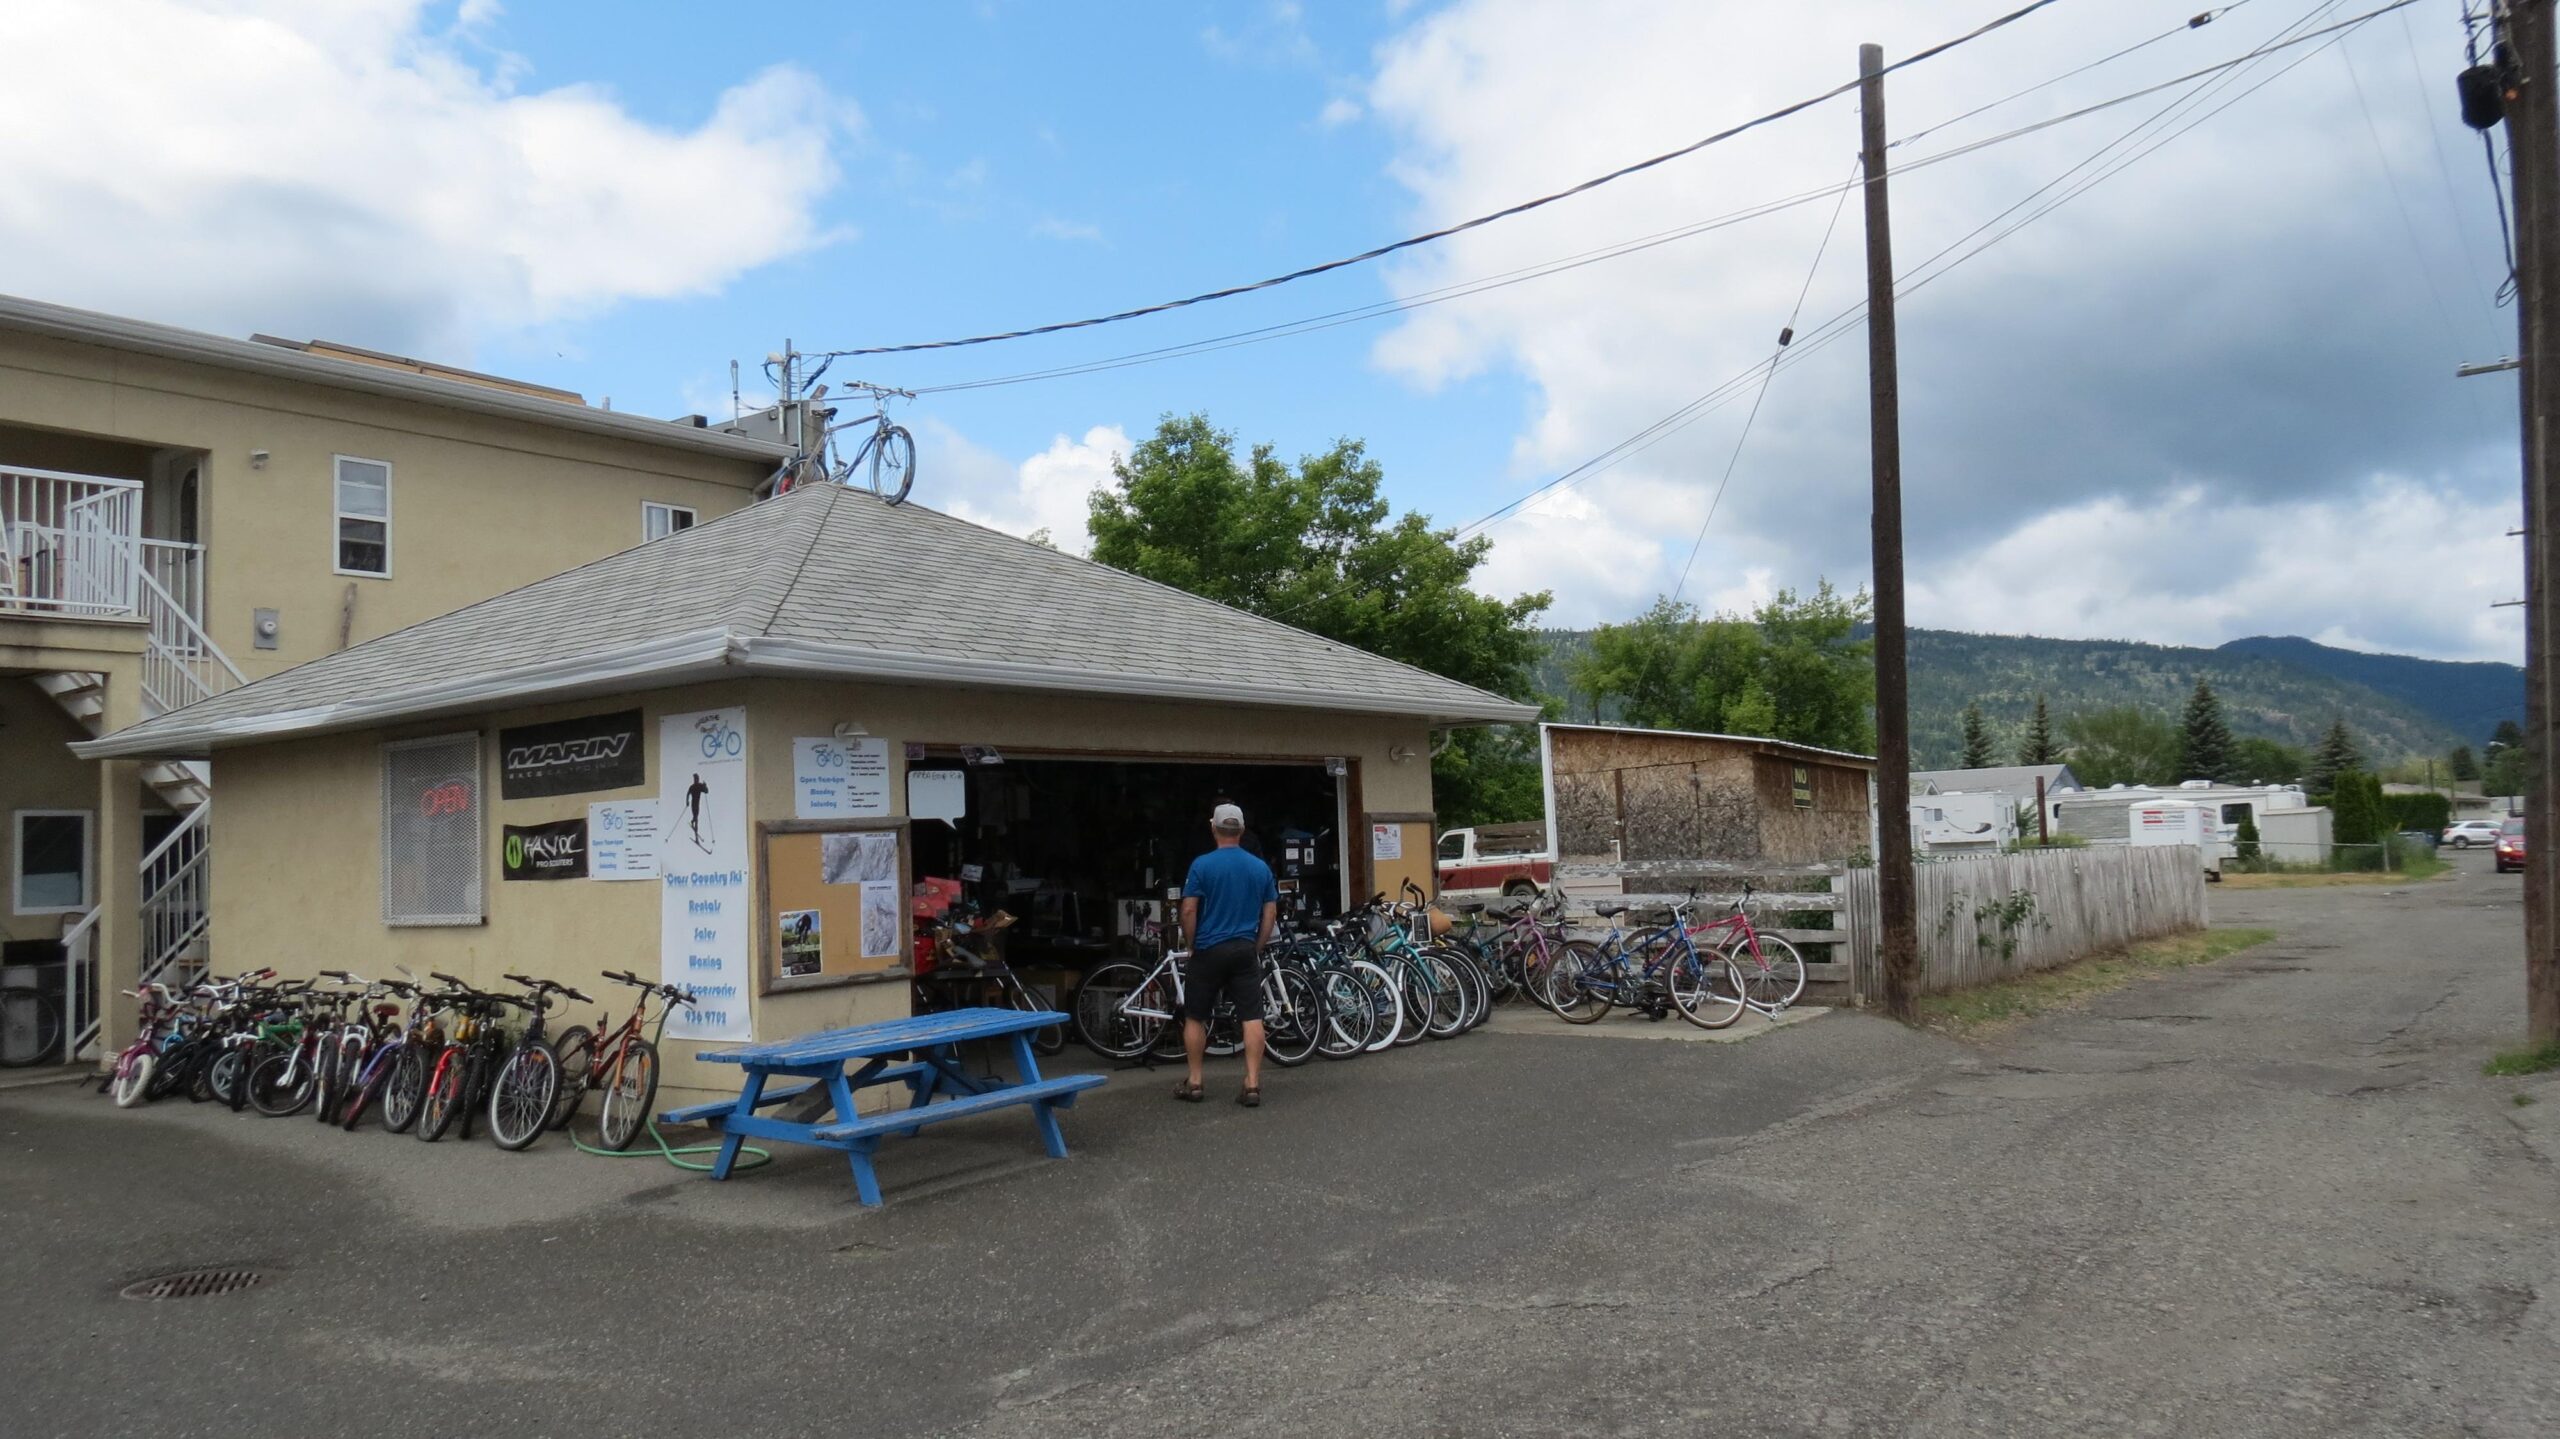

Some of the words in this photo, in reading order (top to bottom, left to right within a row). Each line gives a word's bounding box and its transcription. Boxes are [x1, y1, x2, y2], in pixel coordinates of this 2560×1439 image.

[507, 732, 631, 770] MARIN
[1794, 767, 1807, 785] NO
[523, 834, 585, 866] HAVOC
[667, 873, 689, 886] Cross
[690, 871, 728, 886] Country
[729, 870, 743, 883] Ski
[688, 899, 722, 914] Rentals
[694, 927, 717, 941] Sales
[689, 955, 722, 970] Waxing
[686, 983, 737, 998] Accessories
[685, 1010, 703, 1024] 936
[704, 1010, 727, 1024] 9702
